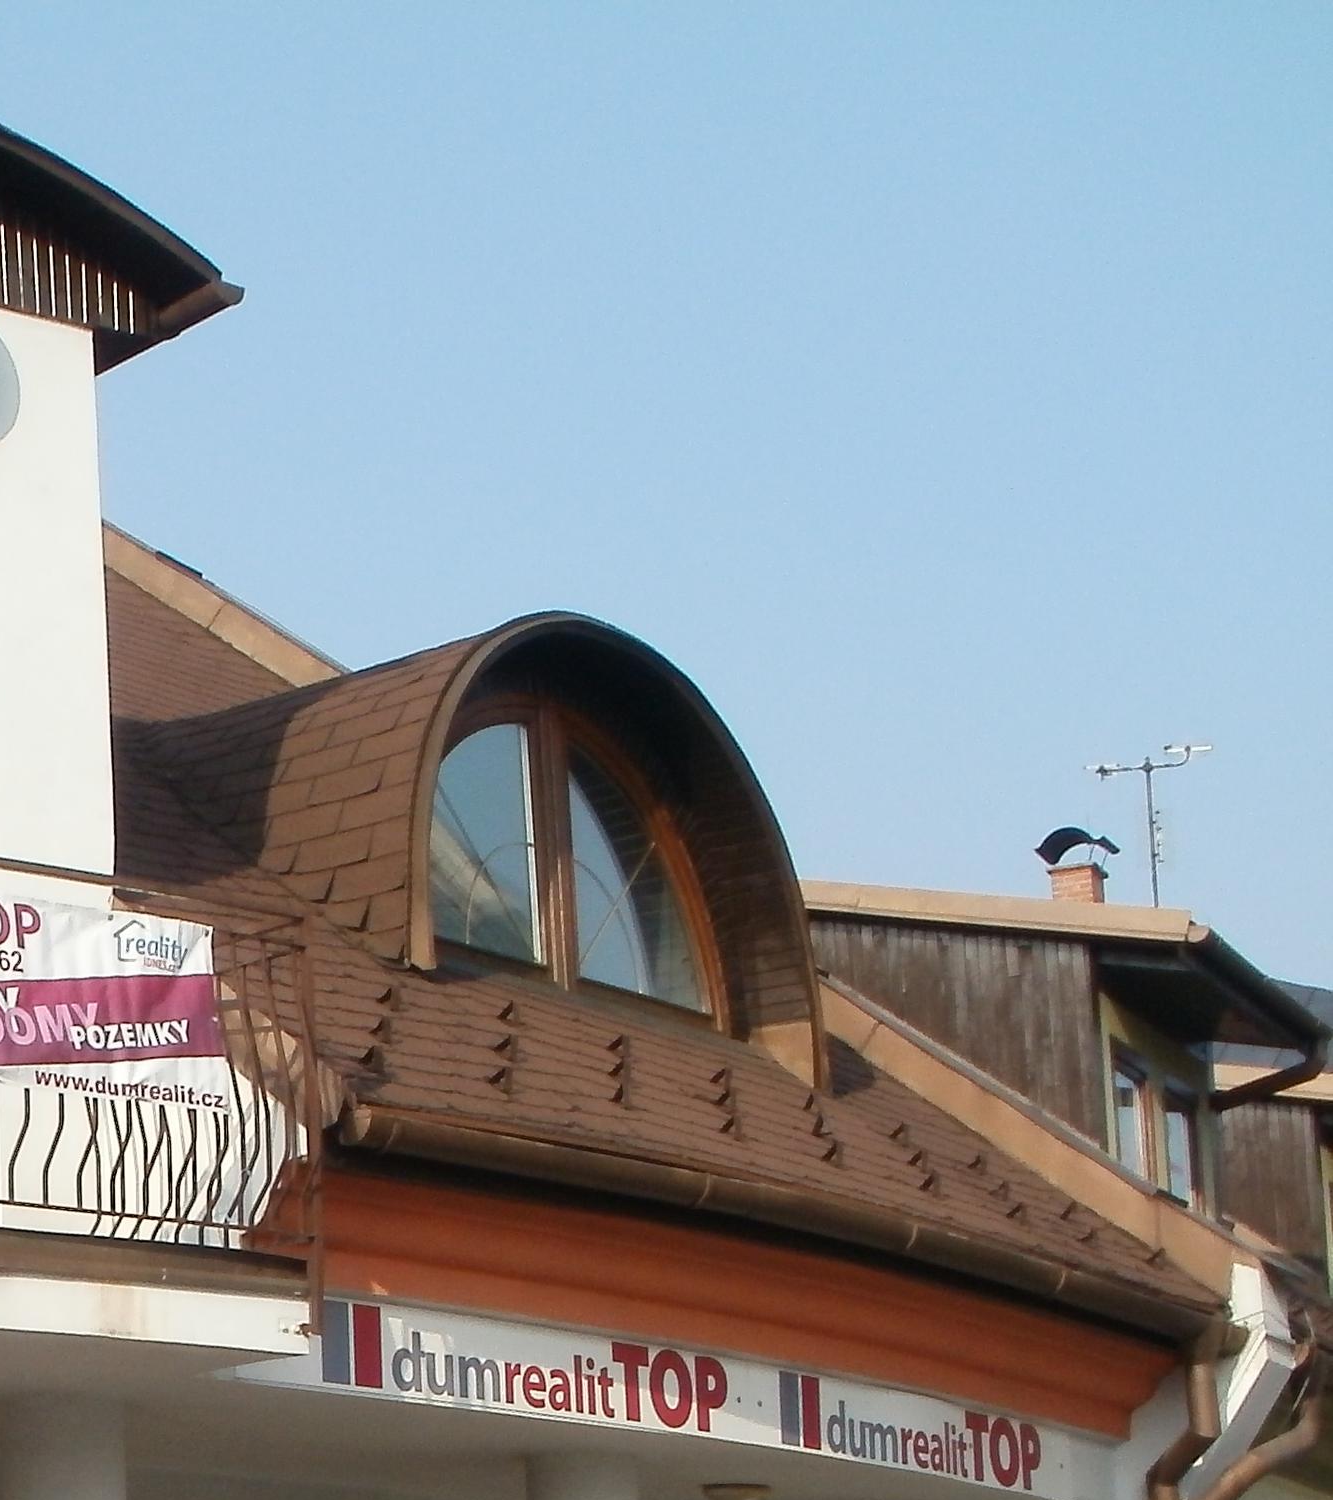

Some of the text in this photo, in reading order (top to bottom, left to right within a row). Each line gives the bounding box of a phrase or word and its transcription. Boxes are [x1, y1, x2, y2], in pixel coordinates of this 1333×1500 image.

[125, 935, 189, 970] reality
[69, 1019, 190, 1051] POZEMKY
[34, 1069, 224, 1109] www.dumrealit.cz
[390, 1331, 729, 1433] dumrealitTOP
[825, 1400, 1042, 1492] dumrealitTOP
